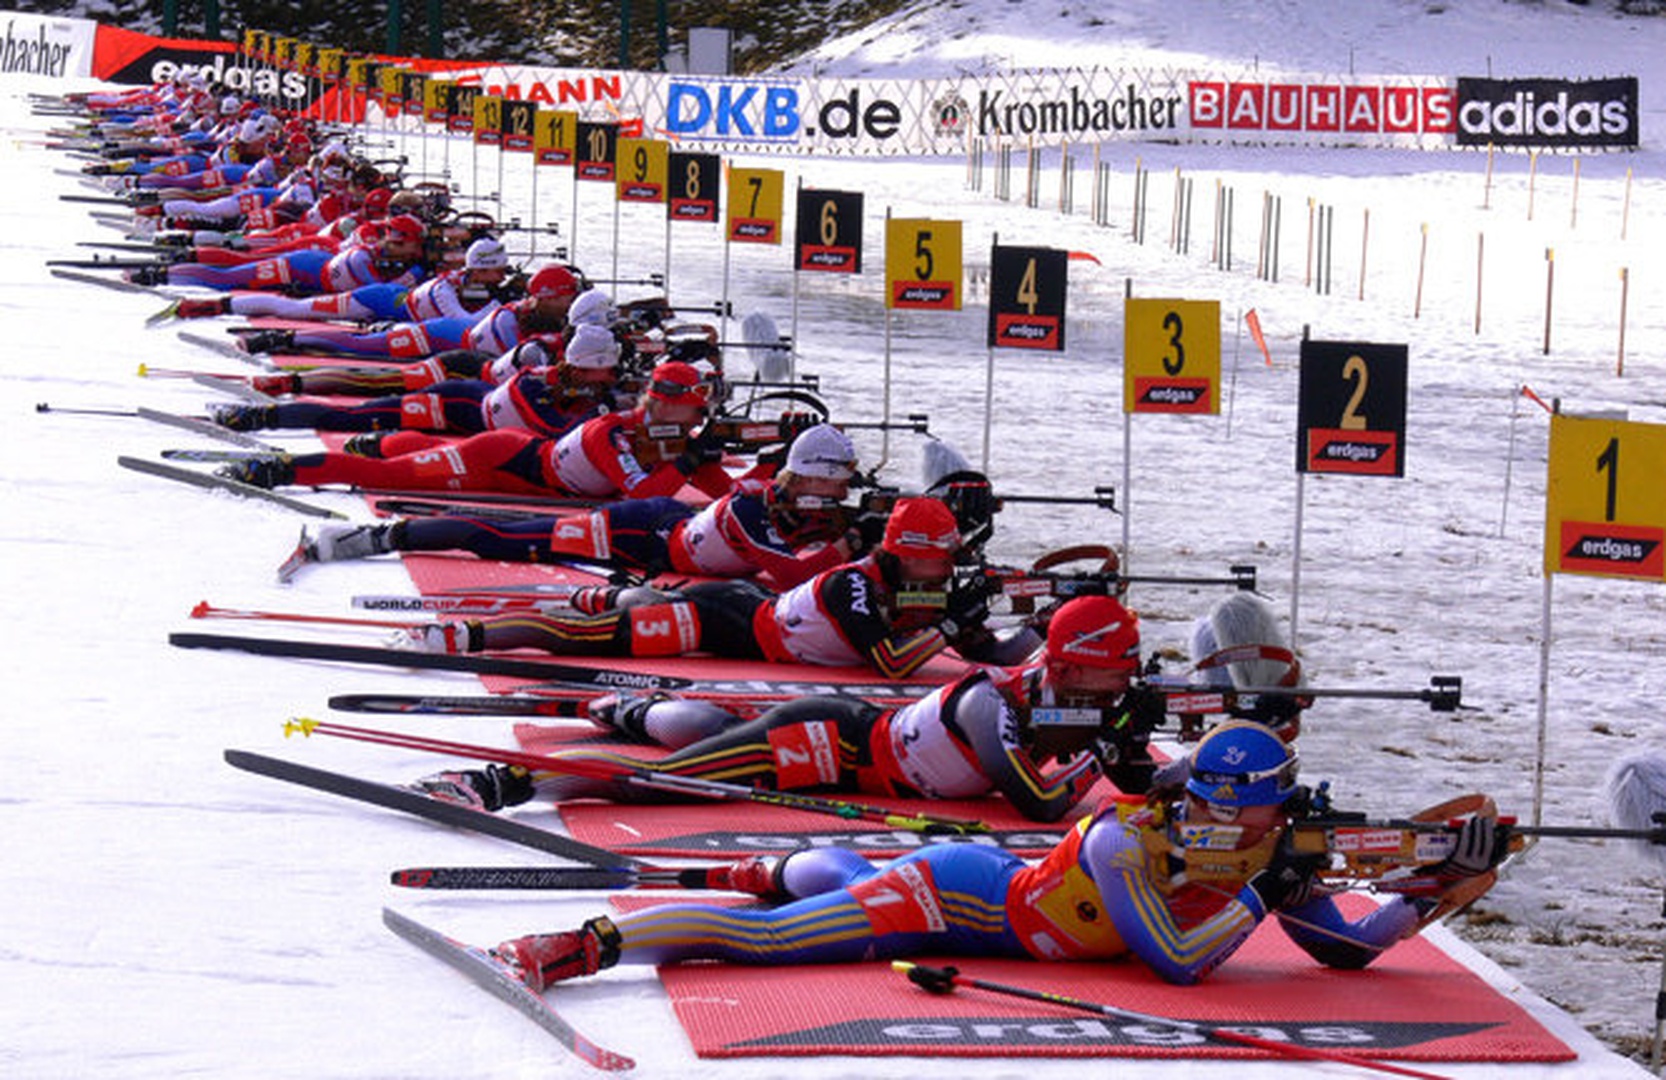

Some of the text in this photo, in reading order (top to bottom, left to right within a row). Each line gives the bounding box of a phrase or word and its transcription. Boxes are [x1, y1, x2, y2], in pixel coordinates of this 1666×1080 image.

[457, 90, 473, 116] 14
[483, 102, 497, 128] 13
[978, 84, 1182, 136] Krombacher
[1193, 87, 1452, 128] BAUHAUS
[1460, 92, 1629, 135] adidas
[511, 106, 529, 136] 12
[548, 117, 564, 148] 11
[588, 129, 608, 162] 10
[634, 147, 648, 183] 9
[686, 160, 701, 199] 8
[749, 178, 763, 218] 7
[820, 200, 838, 246] 6
[915, 231, 933, 281] 5
[1017, 258, 1039, 315] 4
[391, 335, 411, 348] 8
[1163, 311, 1184, 375] 3
[404, 366, 426, 376] 7
[1150, 387, 1195, 402] erdgas
[1340, 354, 1369, 430] 2
[403, 401, 427, 415] 6
[413, 452, 441, 464] 5
[1327, 442, 1379, 461] erdgas
[1596, 437, 1619, 522] 1
[556, 524, 585, 540] 4
[1582, 537, 1643, 560] erdgas
[636, 620, 670, 637] 3
[595, 671, 661, 689] ATOMIC
[904, 727, 920, 746] 2
[777, 743, 811, 768] 2
[864, 888, 905, 907] 1
